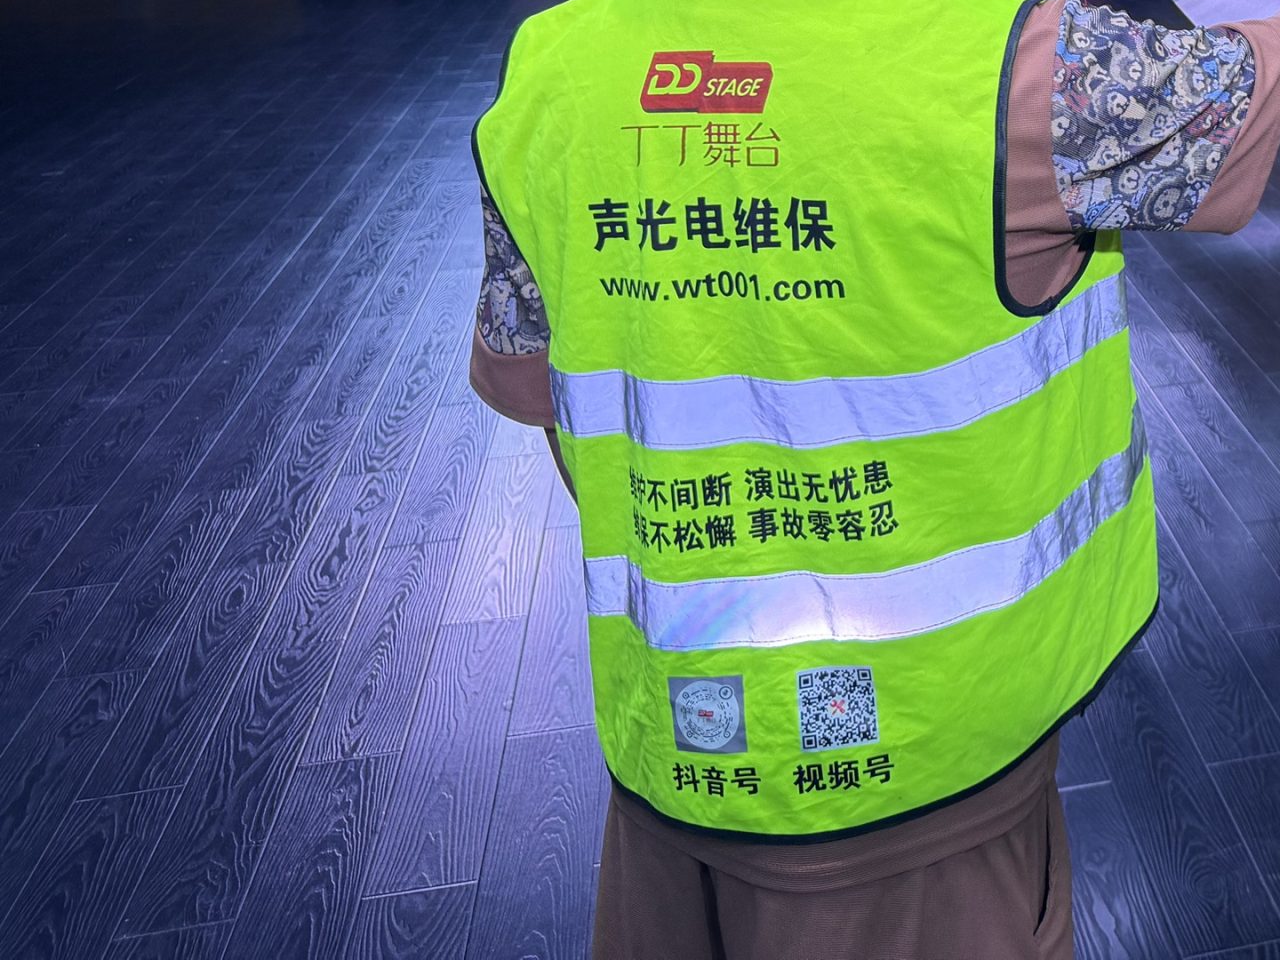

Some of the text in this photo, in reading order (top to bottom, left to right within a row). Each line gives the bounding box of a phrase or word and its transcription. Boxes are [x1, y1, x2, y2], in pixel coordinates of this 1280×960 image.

[703, 78, 764, 97] STAGE
[620, 121, 781, 167] 丁丁舞台
[588, 197, 836, 253] 声光电维保
[600, 271, 846, 301] www.wt001.com
[744, 460, 893, 503] 演出无忧患
[747, 500, 899, 544] 事故零容忍
[672, 754, 895, 797] 抖音号 视频号
